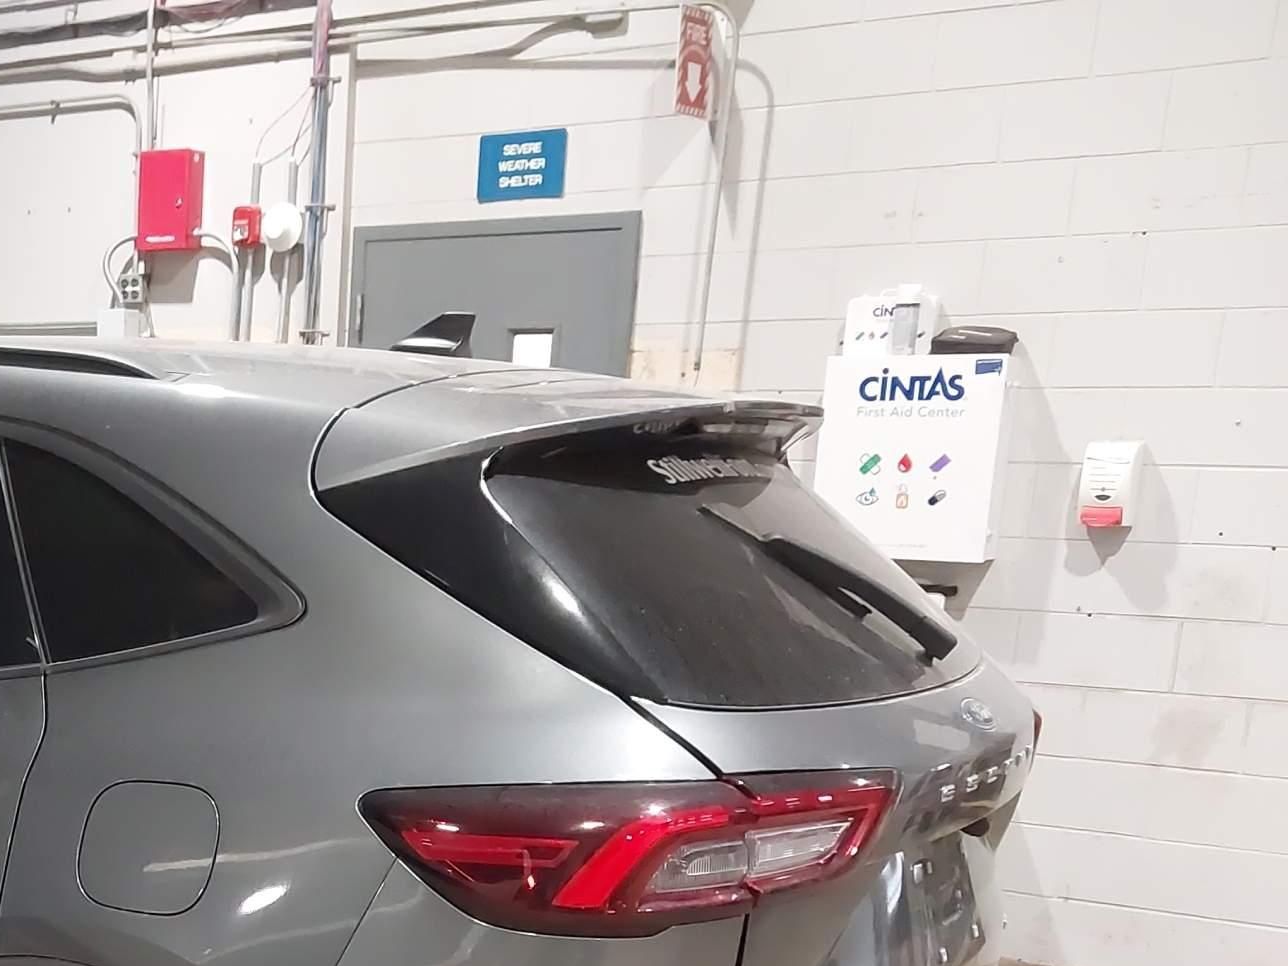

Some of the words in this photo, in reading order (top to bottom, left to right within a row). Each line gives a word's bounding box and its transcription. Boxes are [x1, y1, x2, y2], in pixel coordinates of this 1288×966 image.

[503, 141, 543, 156] SEVERE
[498, 158, 546, 173] WEATHER
[499, 174, 543, 188] SHELTER
[856, 406, 885, 417] First
[890, 406, 913, 417] Aid
[918, 406, 965, 418] Center
[940, 744, 1032, 803] ESC
